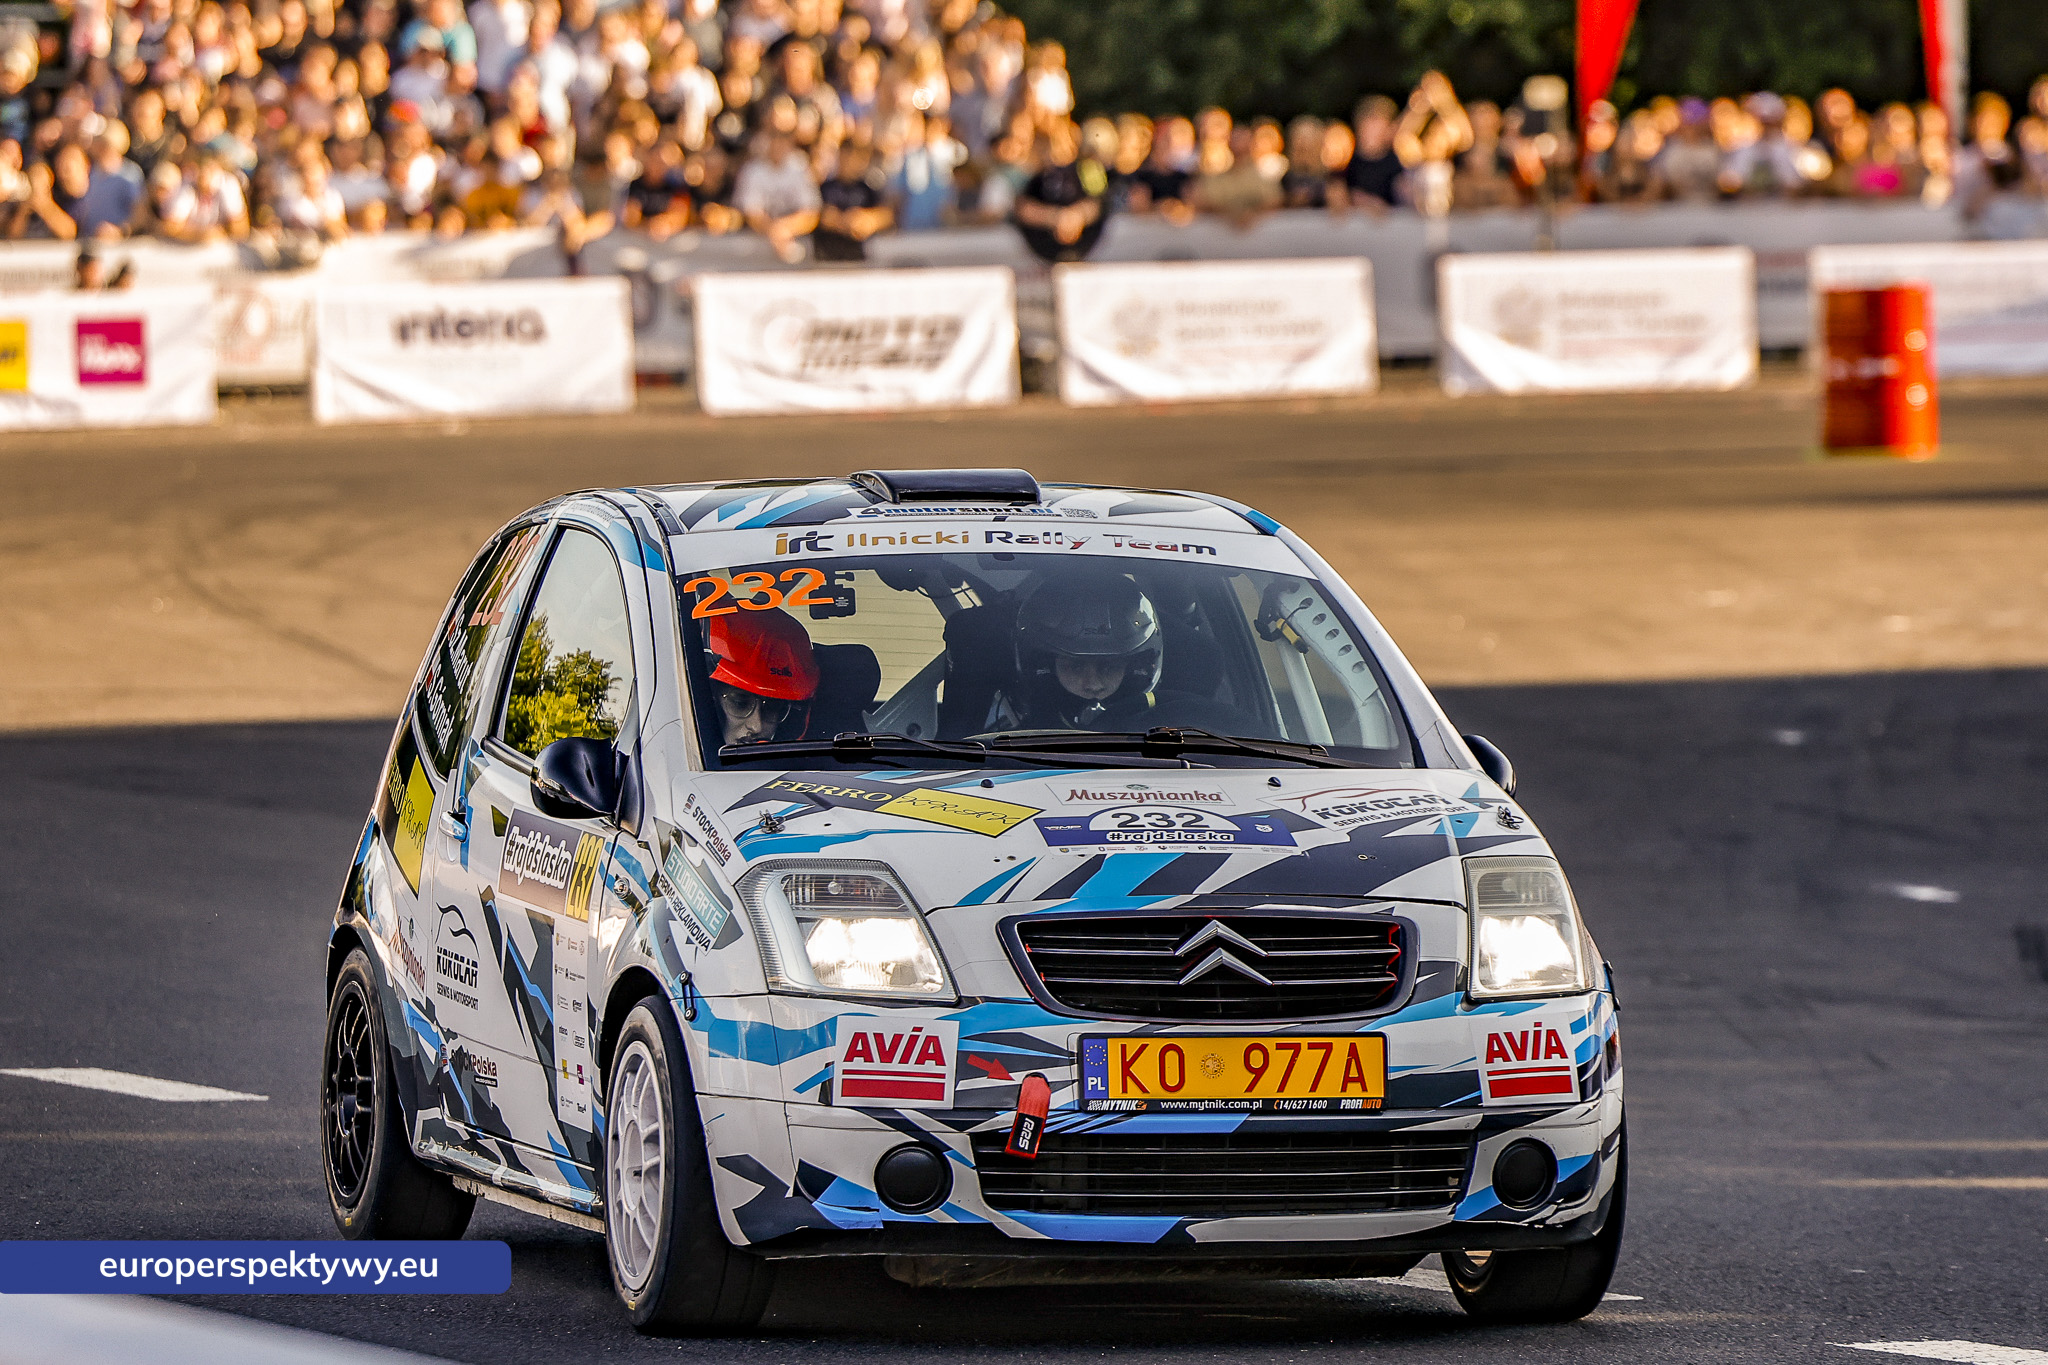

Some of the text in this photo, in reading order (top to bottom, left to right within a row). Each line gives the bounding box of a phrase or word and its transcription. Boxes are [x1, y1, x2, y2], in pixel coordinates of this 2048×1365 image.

[847, 531, 969, 547] Ilnicki
[985, 530, 1092, 550] Rally
[1102, 534, 1217, 556] Team
[683, 567, 834, 619] 232
[764, 780, 893, 802] FERRO
[1065, 788, 1223, 804] Muszynianka
[1111, 812, 1211, 829] 232
[1333, 814, 1381, 828] SERWIS
[1391, 805, 1470, 818] MOTORSPORT
[692, 805, 732, 862] STOCKPolska
[1108, 831, 1232, 843] #rajdslaska
[504, 831, 570, 884] #rajdslaska
[566, 832, 604, 922] 232
[667, 851, 699, 899] STUDIO
[694, 894, 724, 931] ARTE
[658, 873, 712, 952] FIRMA REKLAMOWA
[1243, 1042, 1368, 1093] 977A
[1087, 1076, 1106, 1091] PL
[1100, 1100, 1138, 1111] MYTNIK
[1160, 1100, 1263, 1111] www.mytnik.com.pl
[1340, 1099, 1382, 1110] PROFIAUTO
